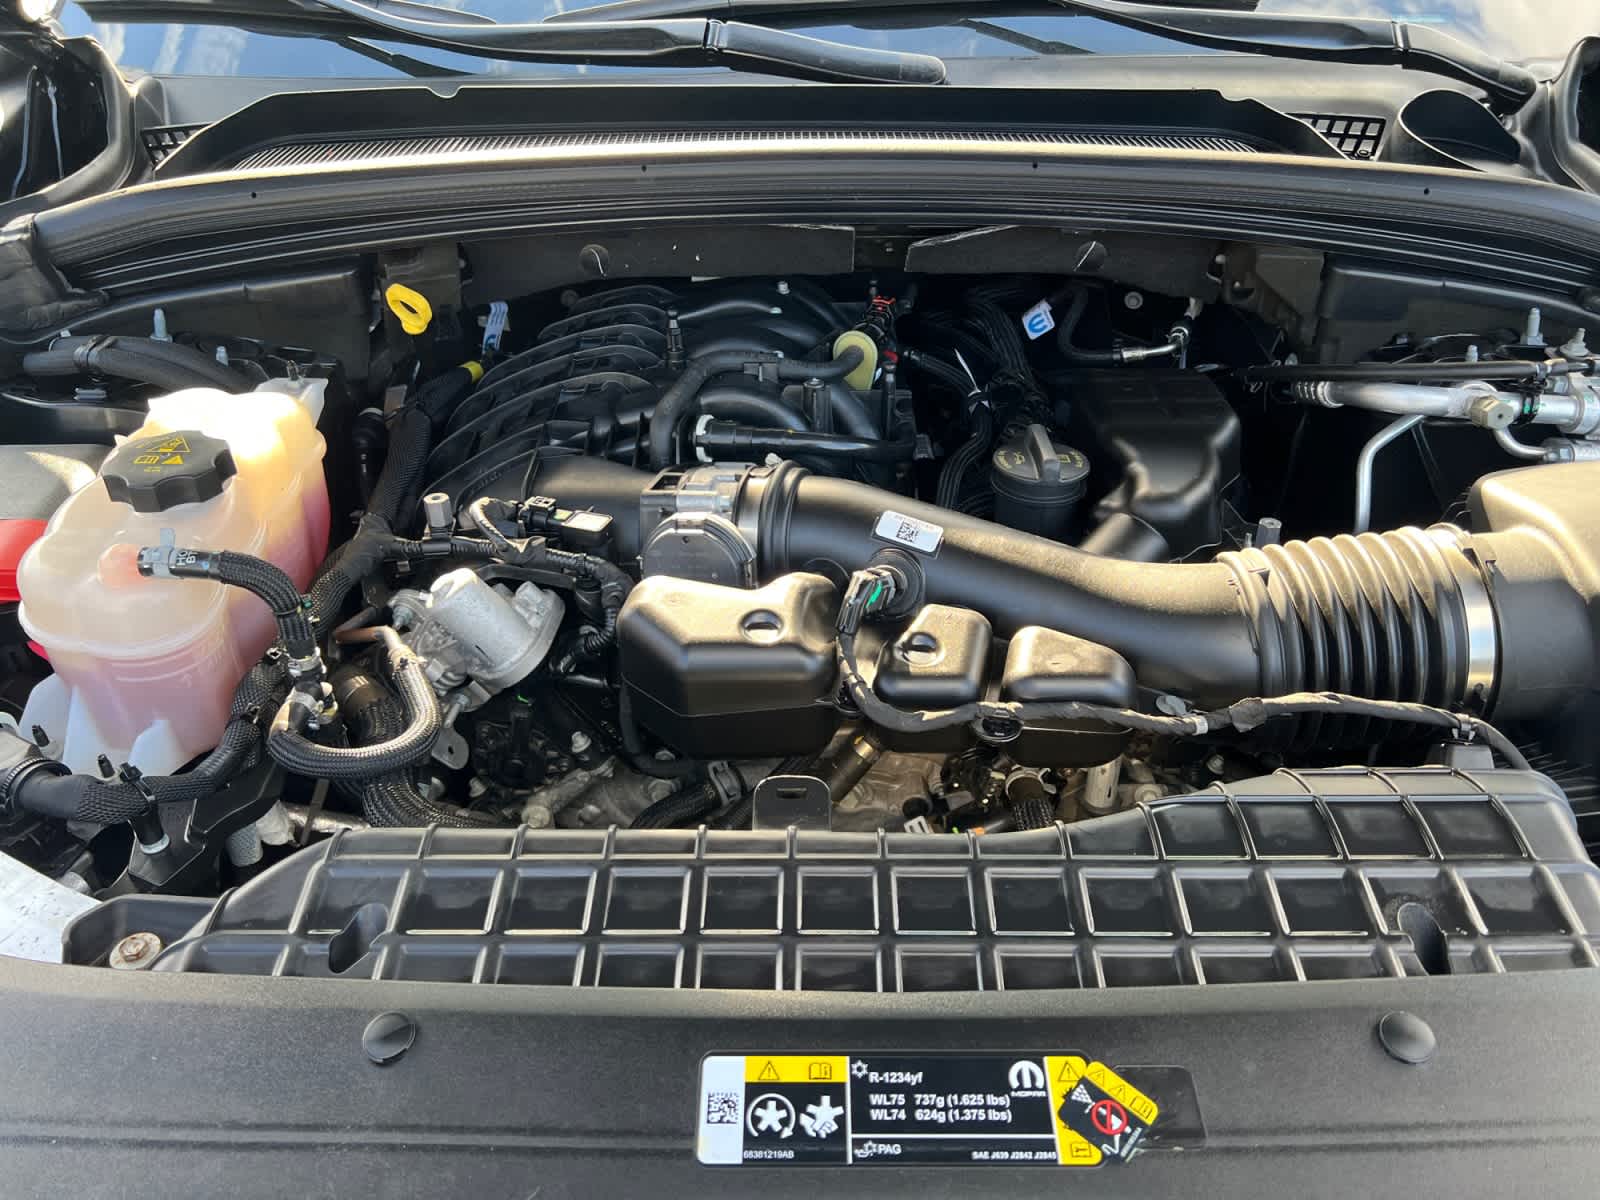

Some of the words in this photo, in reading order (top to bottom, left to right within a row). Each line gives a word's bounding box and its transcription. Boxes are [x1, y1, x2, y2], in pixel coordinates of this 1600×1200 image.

[868, 1071, 924, 1086] R-1234yf
[869, 1093, 906, 1106] WL75
[913, 1094, 945, 1108] 737g
[947, 1094, 985, 1108] (1.625
[987, 1094, 1011, 1108] lbs)
[869, 1109, 906, 1121] WL74
[914, 1109, 947, 1123] 624g
[948, 1109, 986, 1123] (1.375
[988, 1109, 1013, 1123] lbs)
[878, 1143, 902, 1155] PAG
